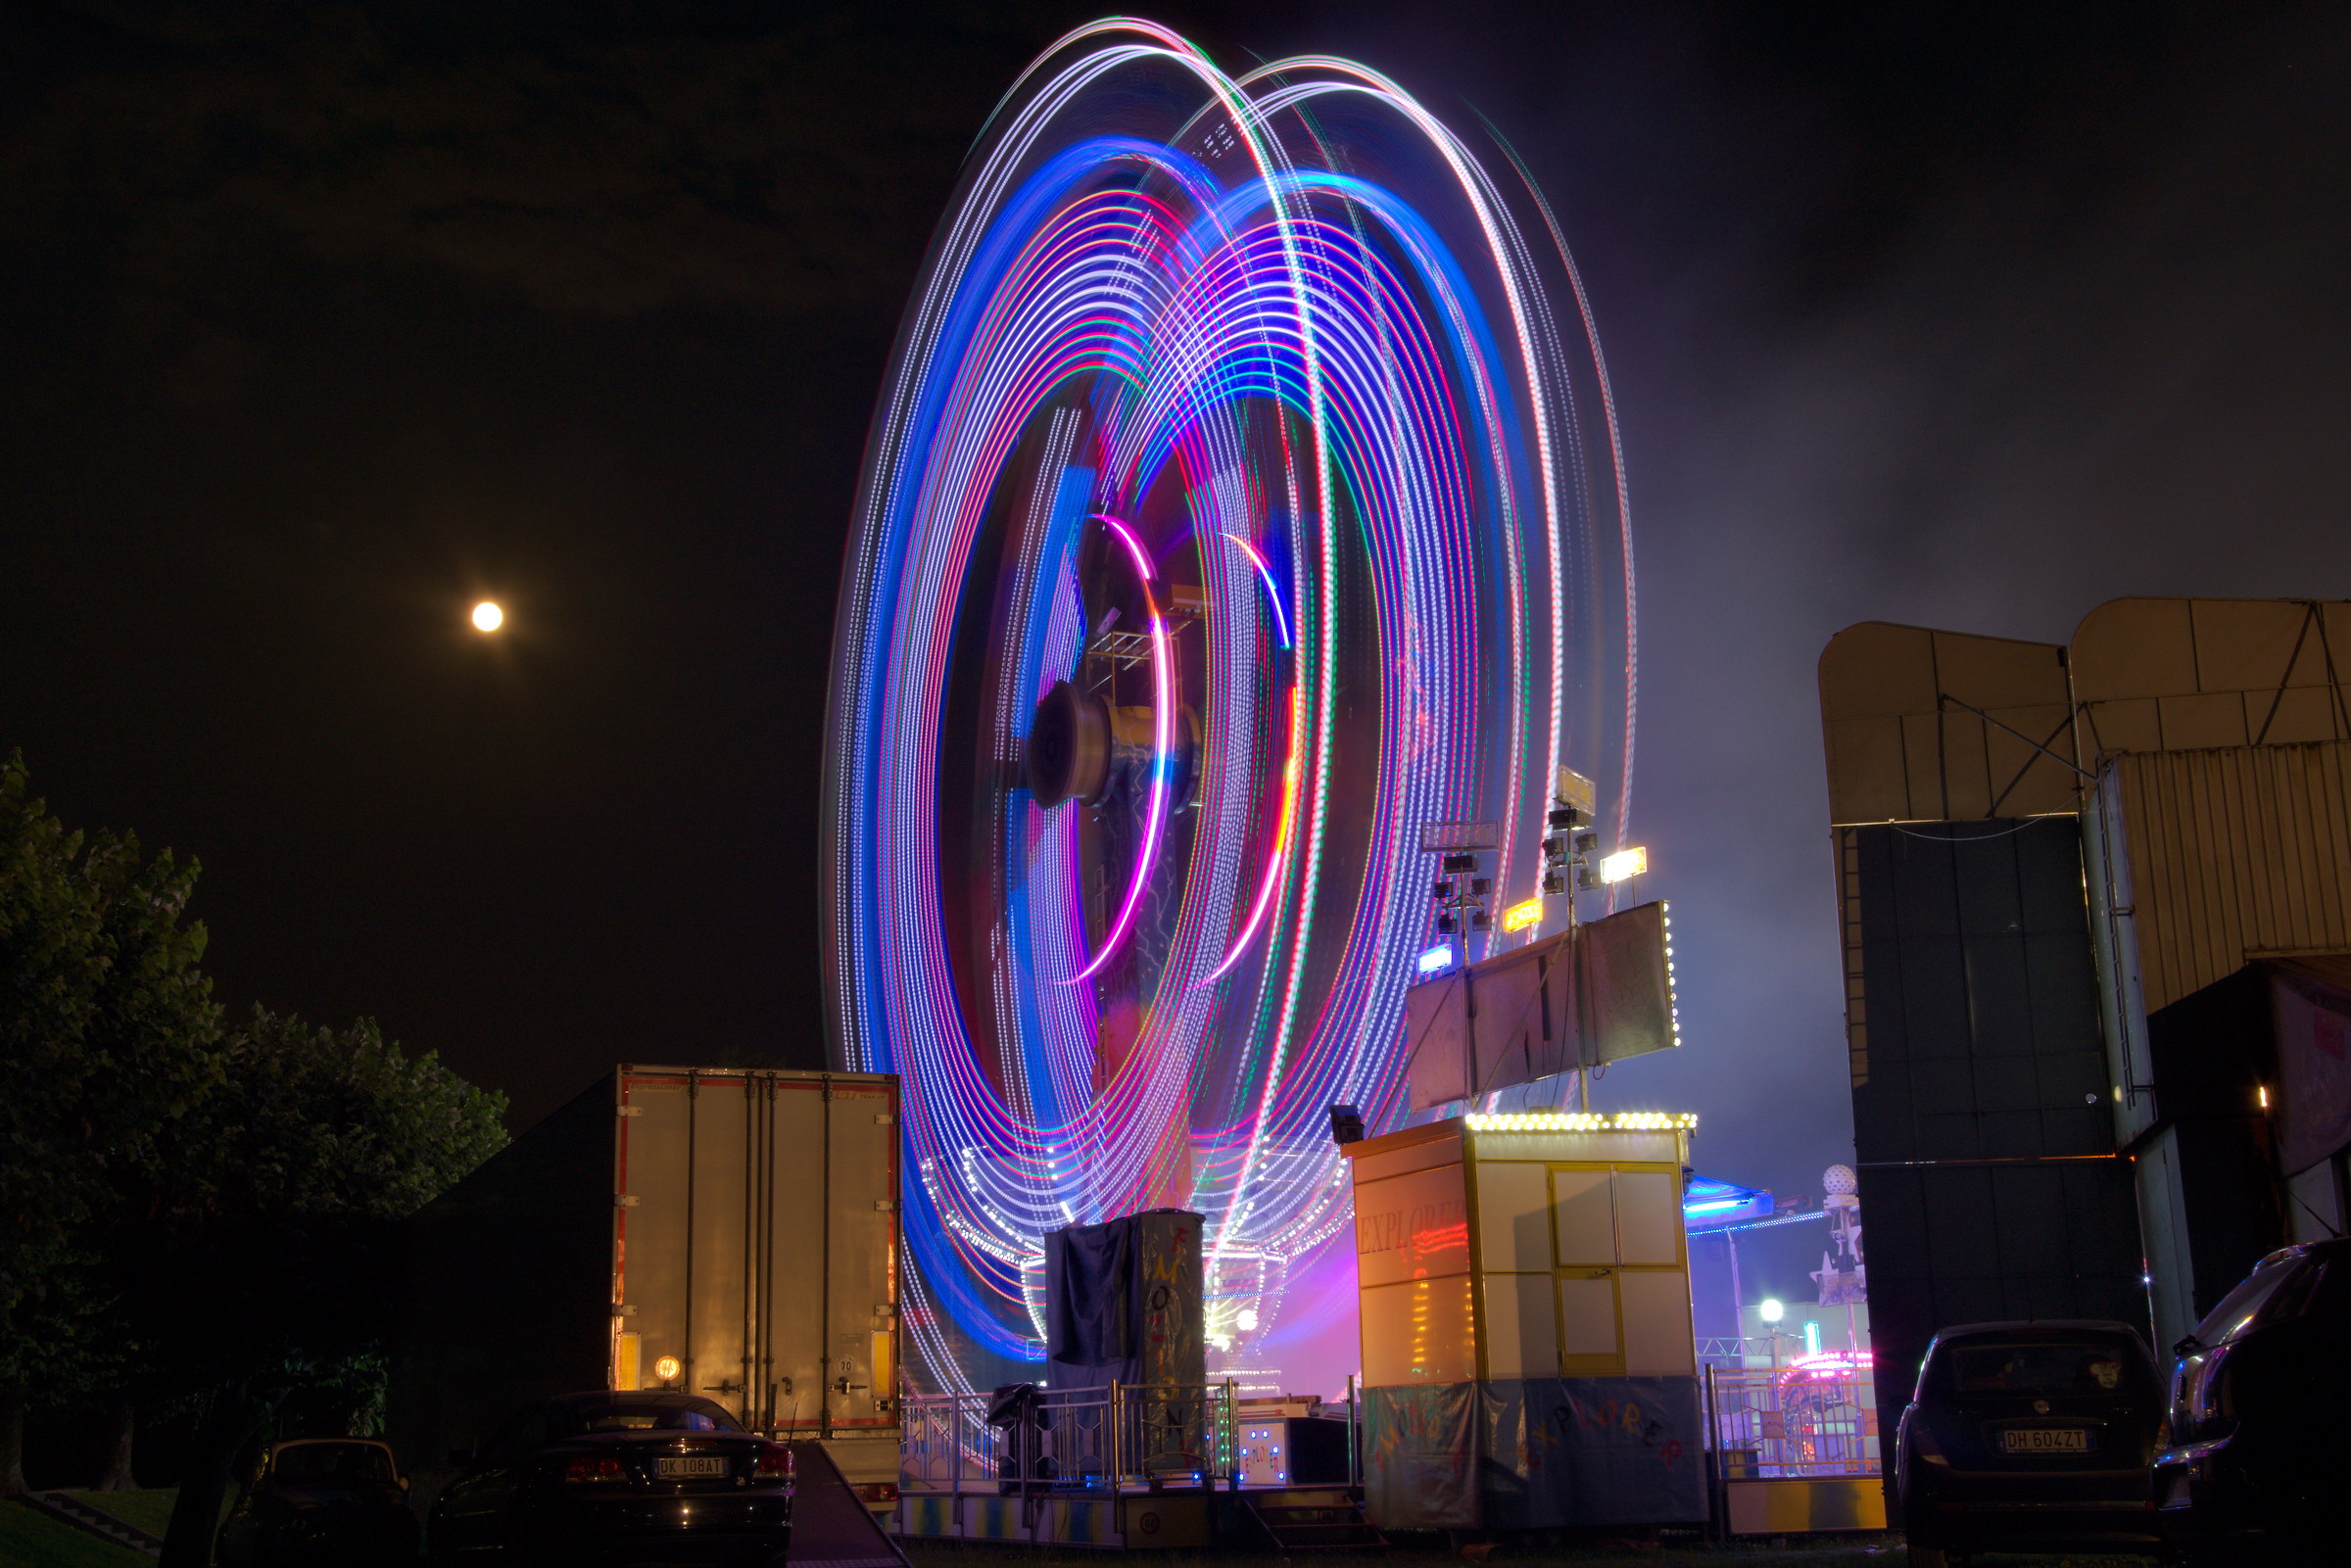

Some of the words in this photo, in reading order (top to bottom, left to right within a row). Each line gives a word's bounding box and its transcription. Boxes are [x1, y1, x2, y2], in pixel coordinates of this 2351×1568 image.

[840, 1360, 851, 1371] 70
[2007, 1432, 2028, 1448] DH
[2033, 1431, 2083, 1448] 604ZT
[660, 1459, 676, 1473] DK
[683, 1458, 721, 1473] 108AT
